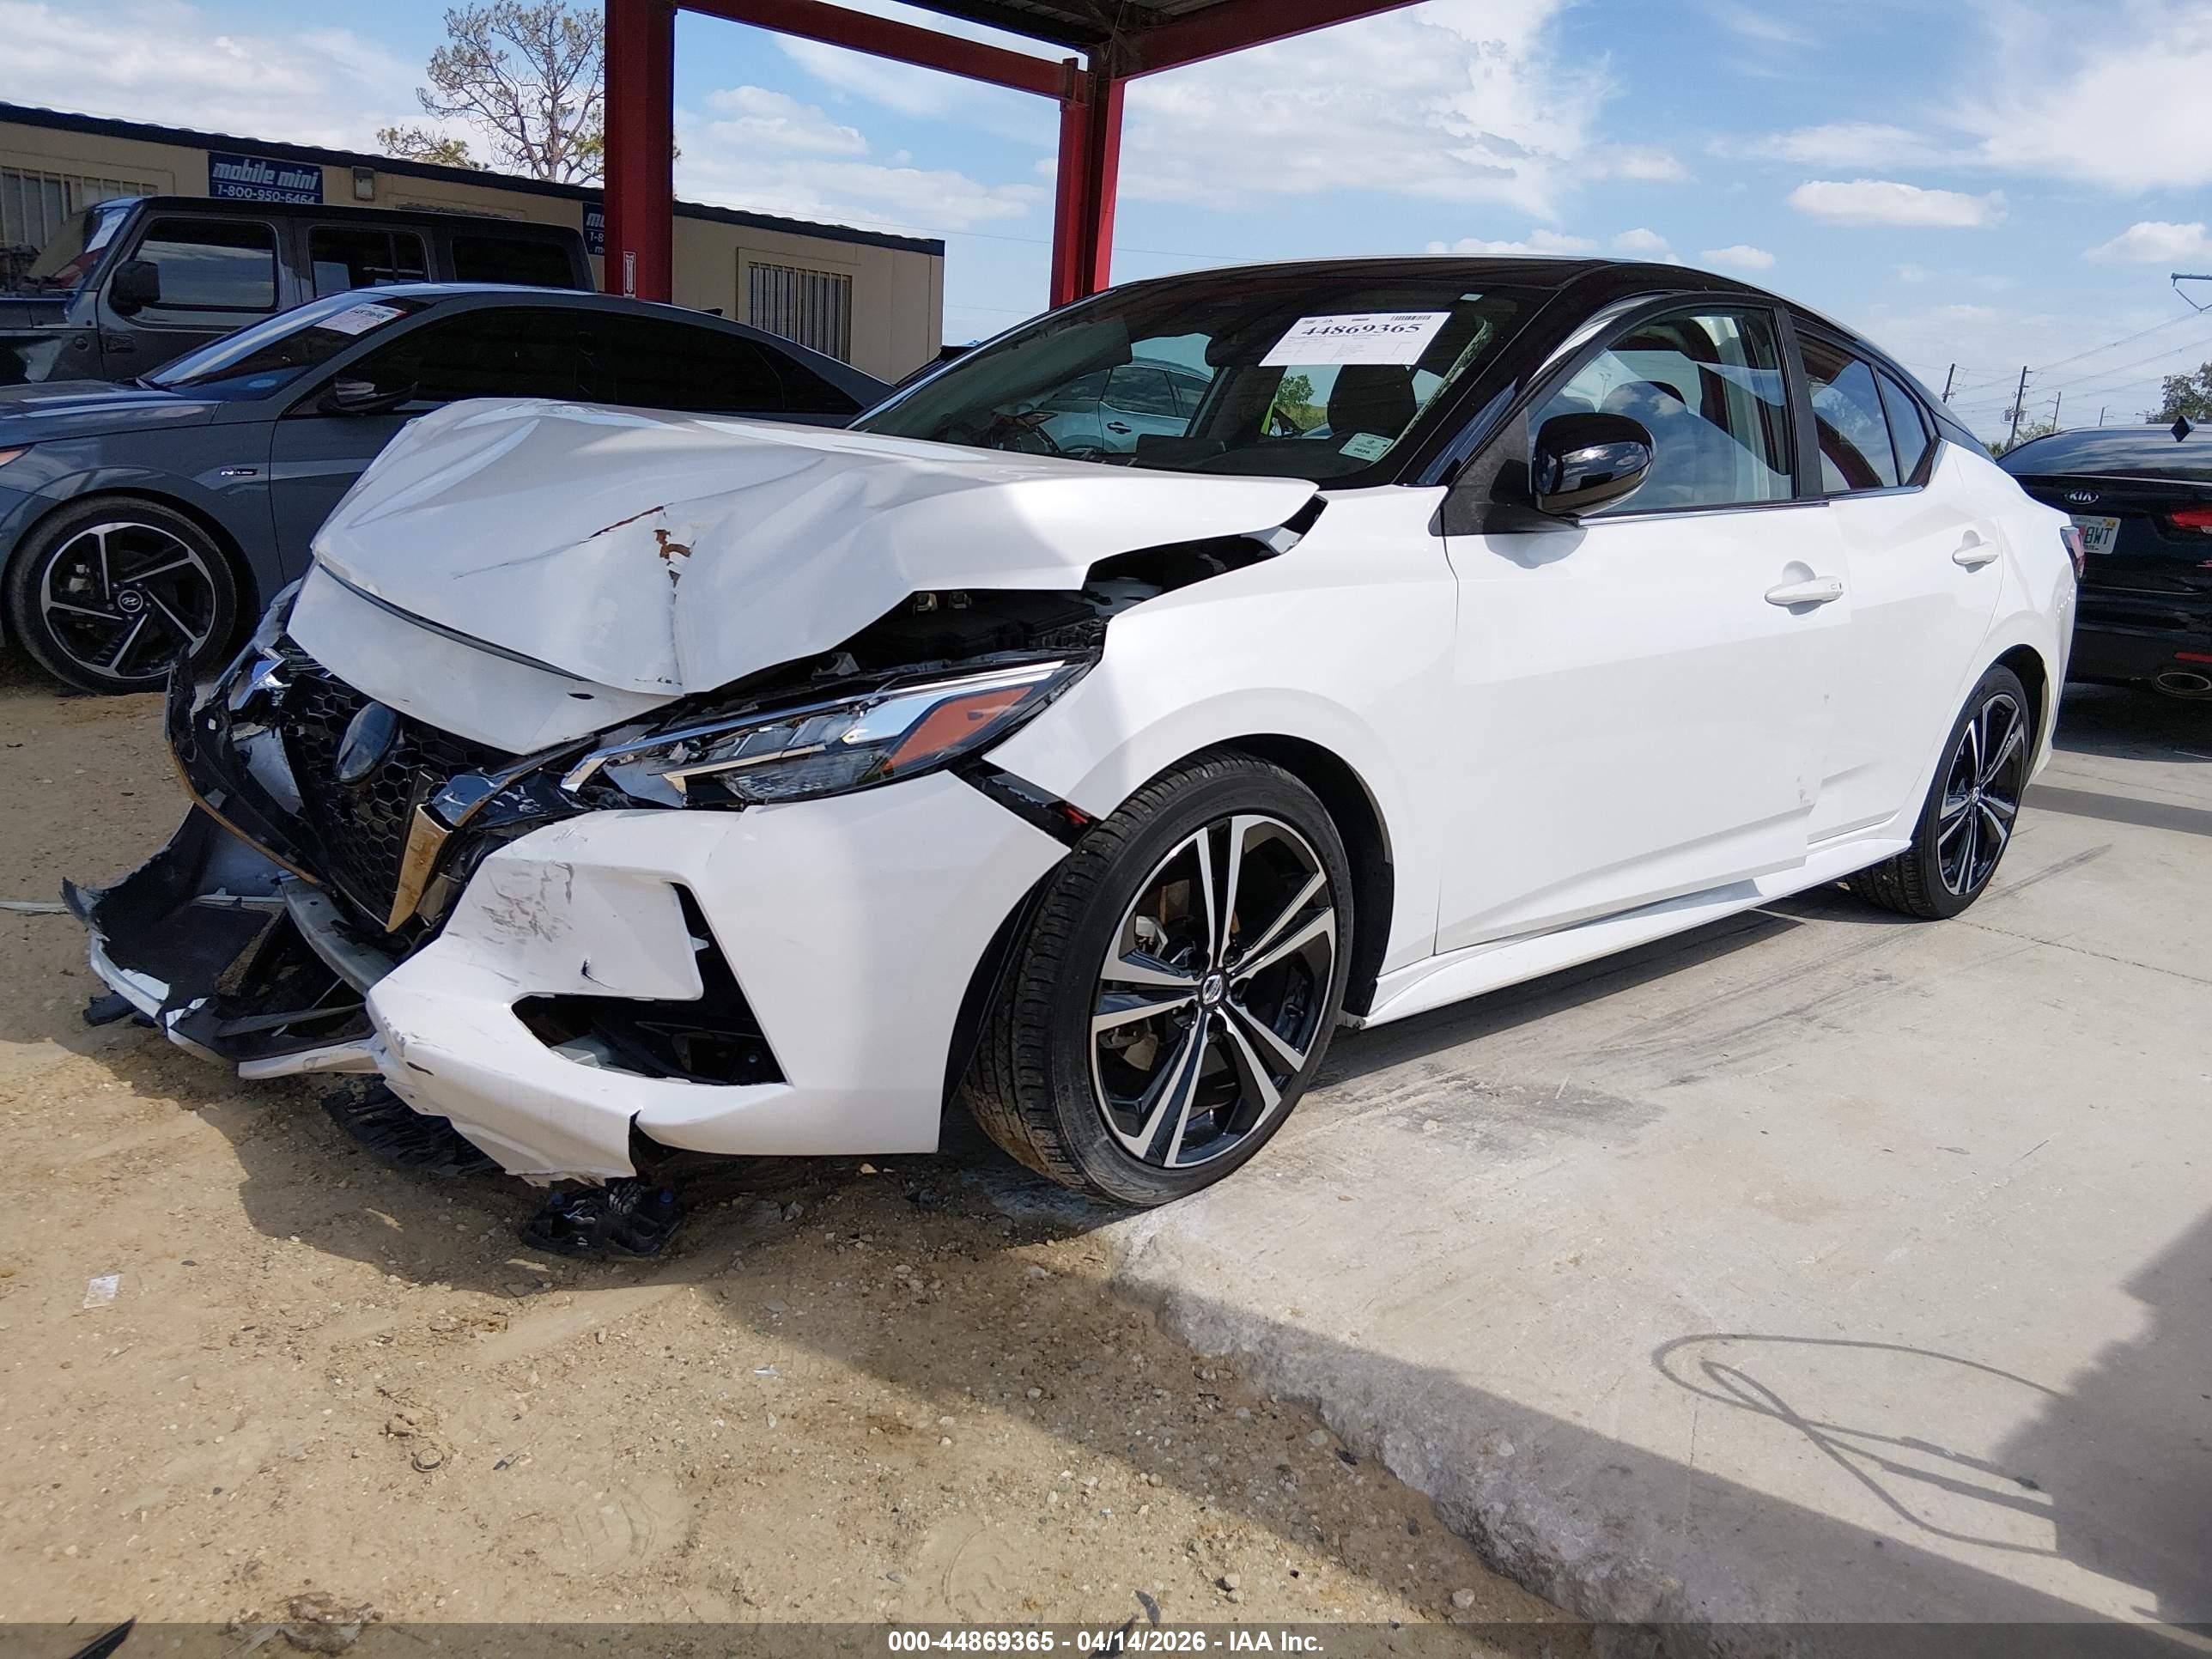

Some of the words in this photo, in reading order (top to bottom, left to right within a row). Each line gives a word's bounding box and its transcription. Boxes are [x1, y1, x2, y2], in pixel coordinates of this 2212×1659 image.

[213, 159, 275, 185] mobile
[277, 169, 319, 190] mini
[217, 184, 316, 204] 1-800-950-6464
[1302, 323, 1423, 336] 44869365
[2069, 491, 2092, 501] KIA
